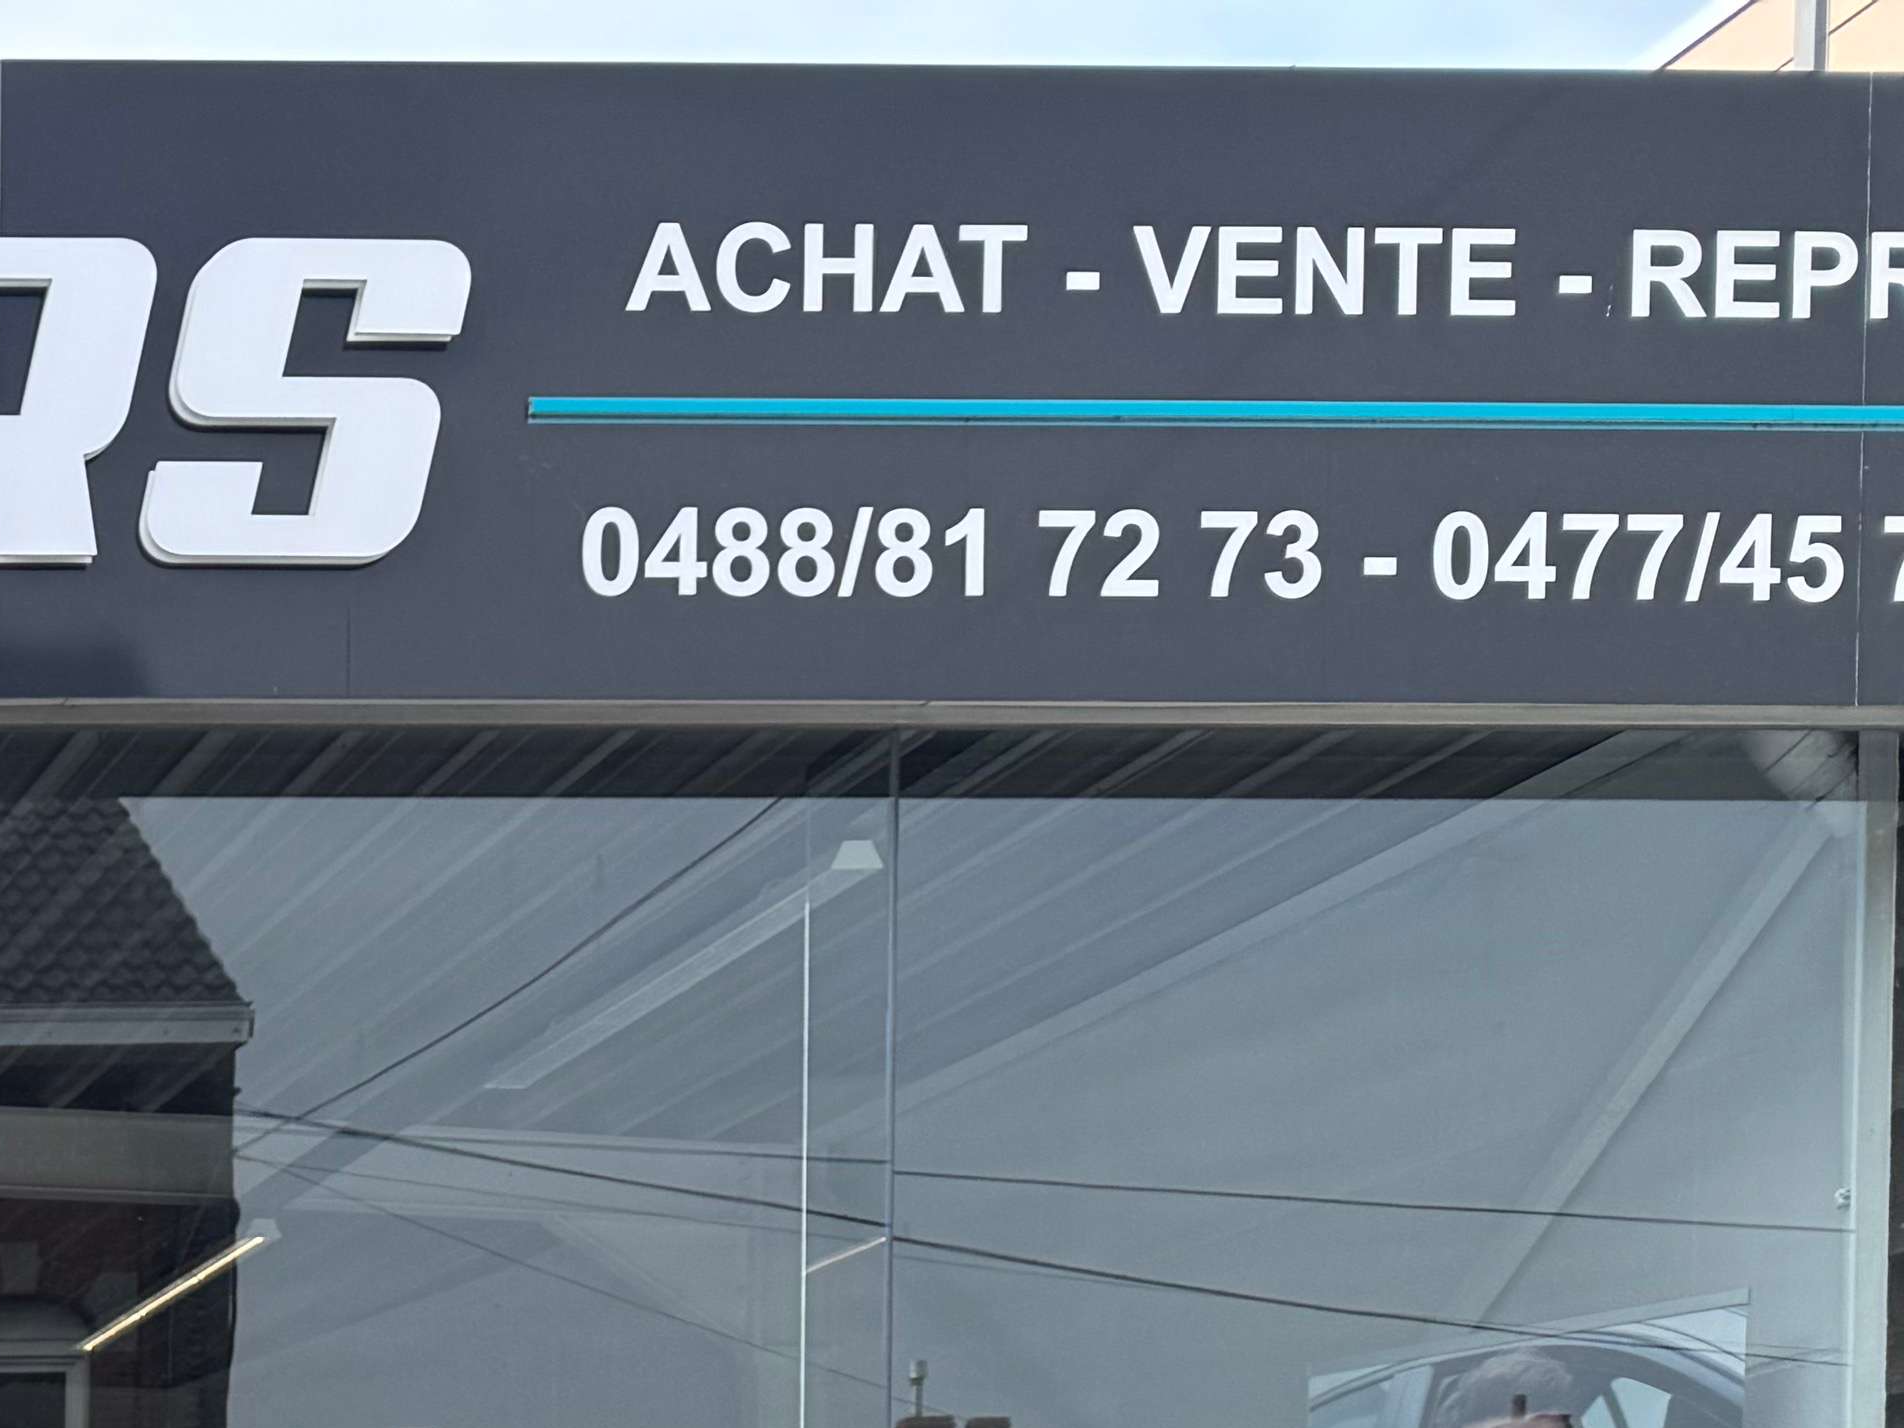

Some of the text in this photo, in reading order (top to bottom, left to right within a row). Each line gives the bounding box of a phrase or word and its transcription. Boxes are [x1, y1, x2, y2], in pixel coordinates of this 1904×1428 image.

[625, 222, 1028, 314] ACHAT
[1066, 268, 1101, 292] -
[1133, 225, 1518, 318] VENTE
[1558, 273, 1592, 295] -
[580, 506, 986, 599] 0488/81
[1037, 509, 1161, 598] 72
[1198, 510, 1323, 598] 73
[1361, 556, 1398, 577] -
[1432, 511, 1846, 603] 0477/45
